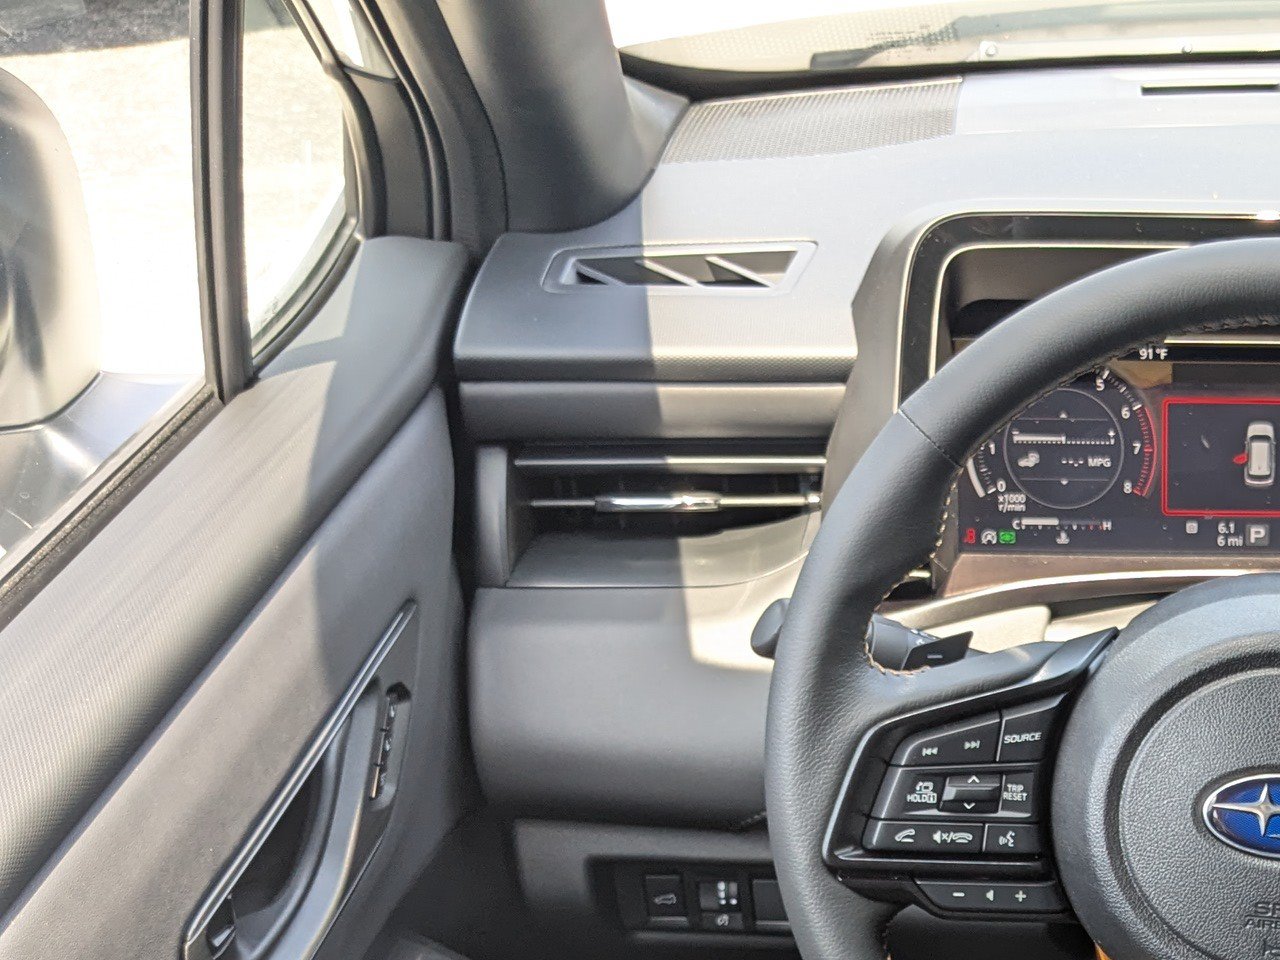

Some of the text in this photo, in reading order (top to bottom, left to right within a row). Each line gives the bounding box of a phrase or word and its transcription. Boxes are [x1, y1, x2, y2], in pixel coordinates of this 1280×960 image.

[1095, 378, 1105, 391] 5
[1121, 405, 1131, 419] 6
[988, 441, 996, 455] 1
[1132, 441, 1142, 455] 7
[1087, 457, 1112, 468] MPG
[997, 480, 1006, 492] 0
[1123, 482, 1132, 494] 8
[997, 503, 1027, 513] r/min
[1102, 520, 1112, 531] H
[1217, 520, 1235, 534] 6.1
[1217, 535, 1244, 547] 6 mi
[1249, 526, 1266, 544] P
[1003, 732, 1042, 744] SOURCE
[1007, 784, 1024, 792] TRIP
[906, 794, 927, 803] HOLD
[1003, 792, 1028, 801] RESET
